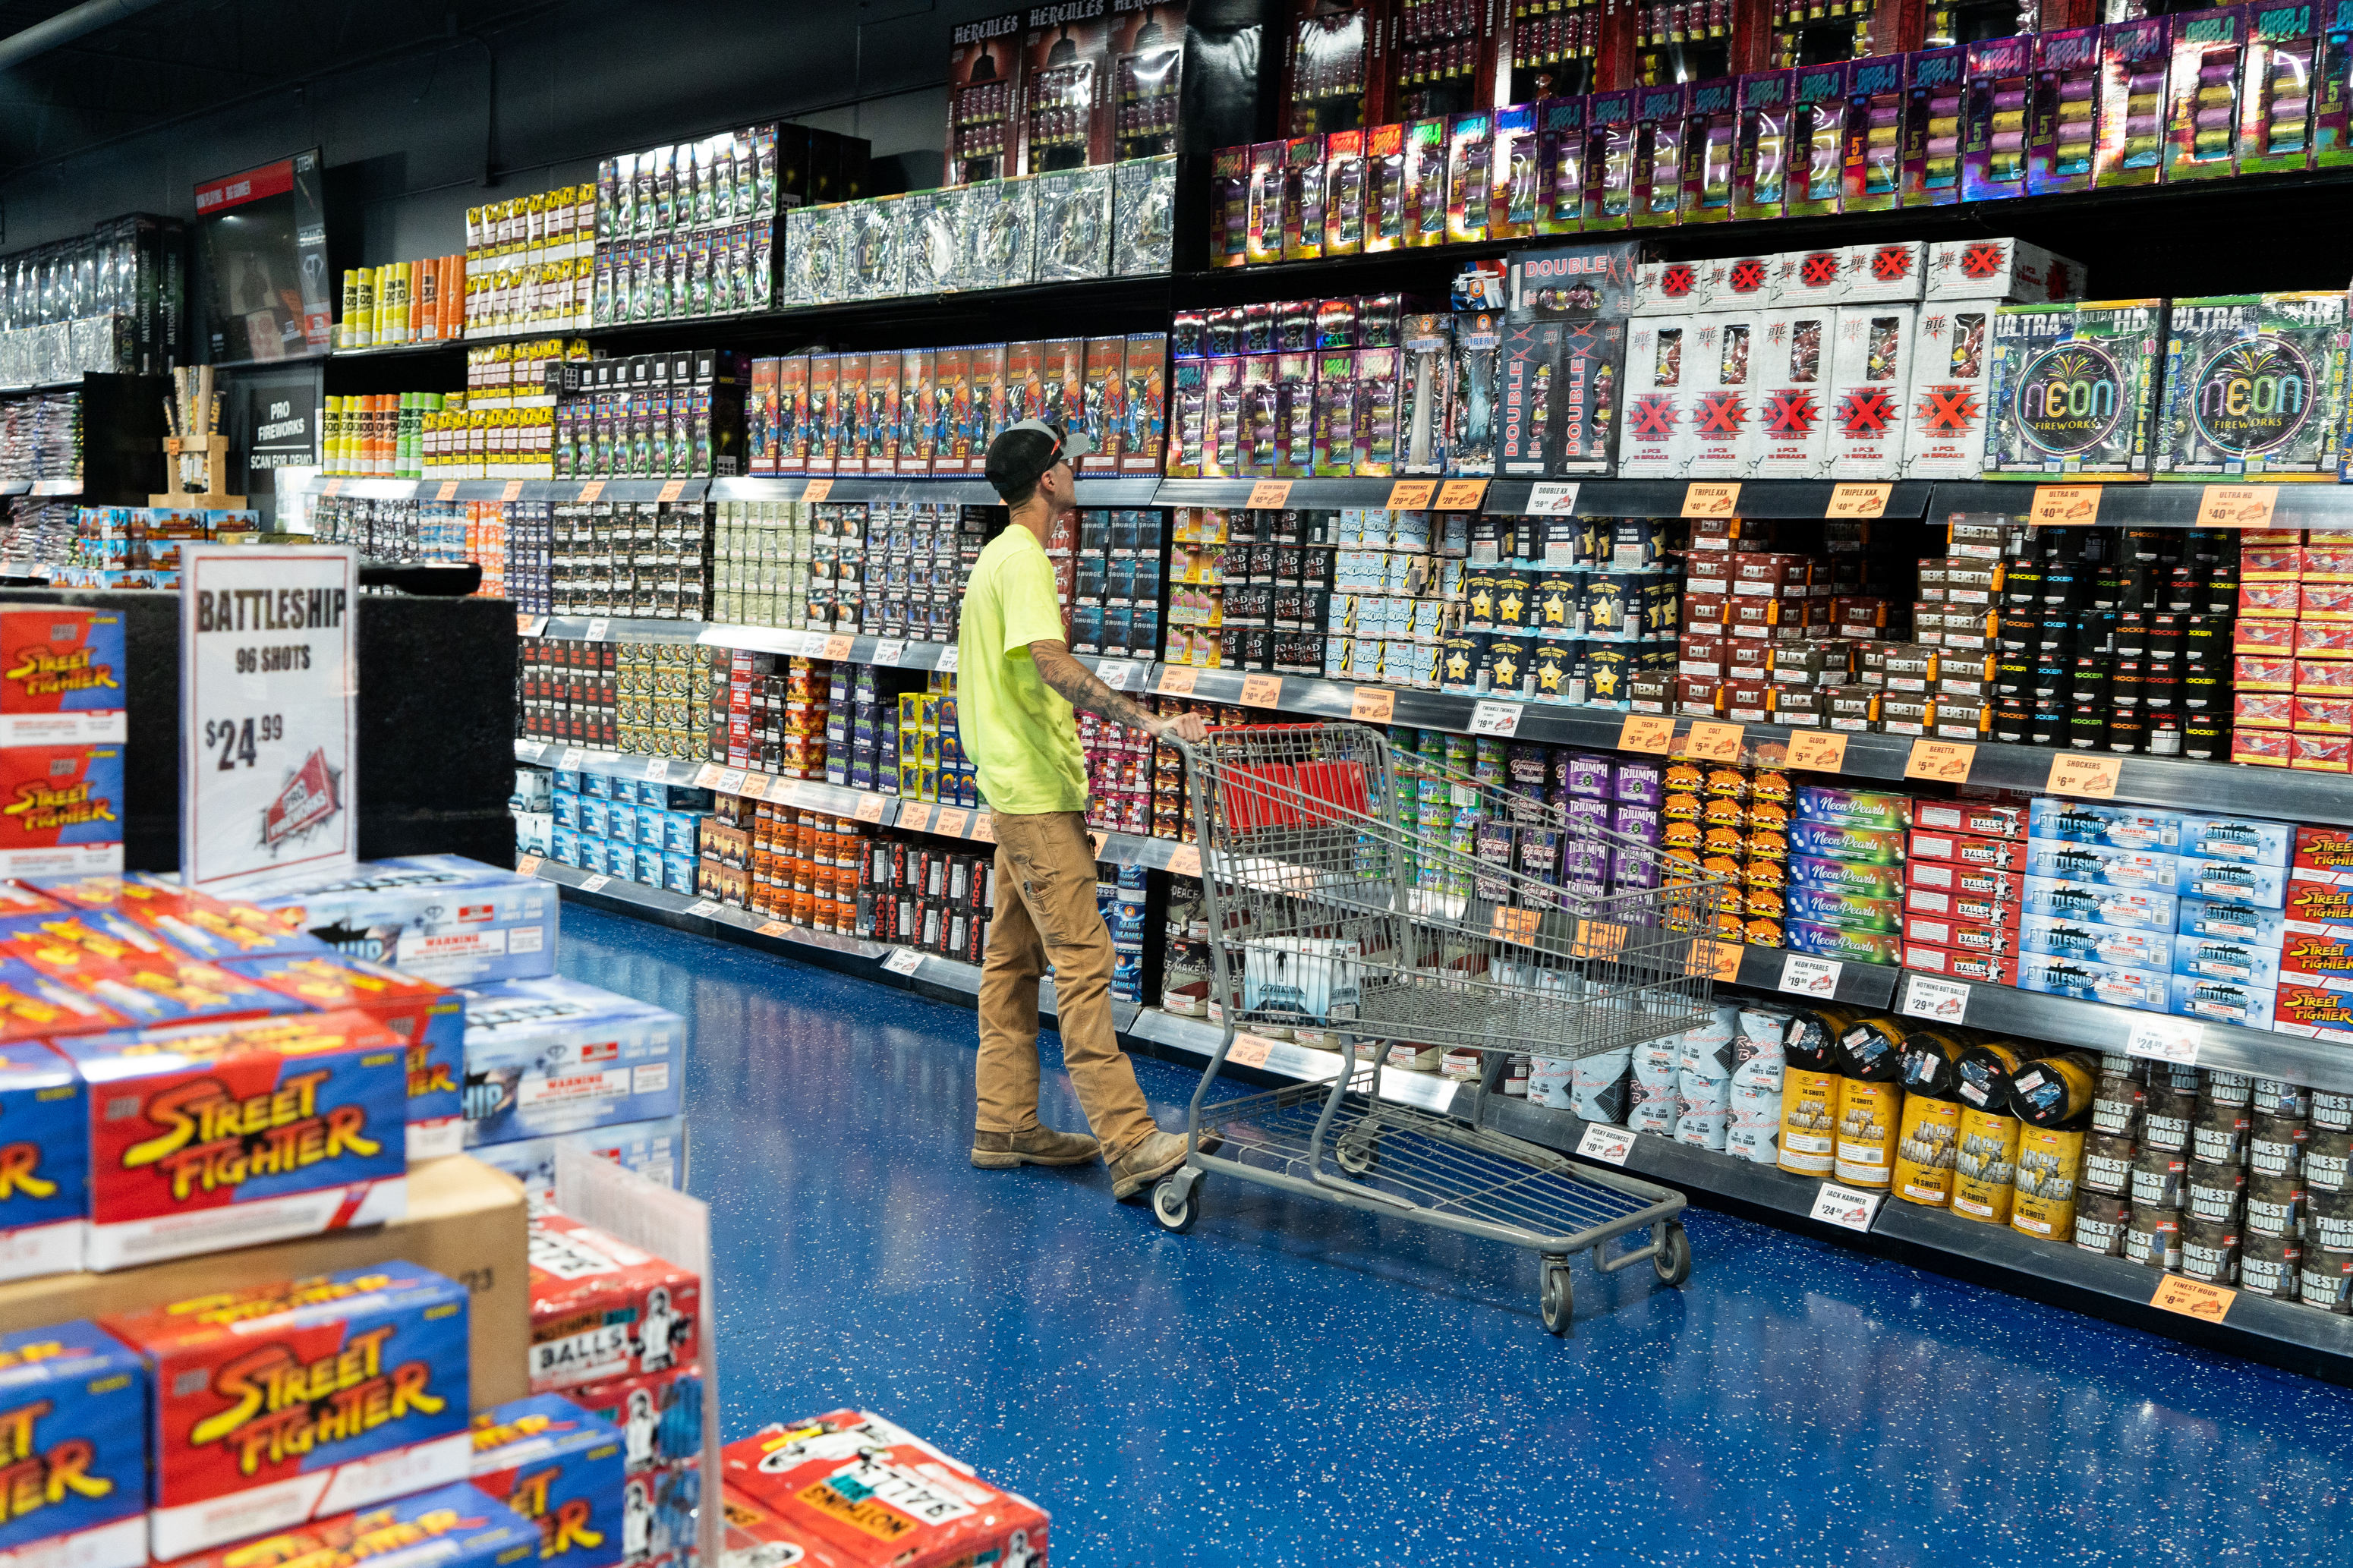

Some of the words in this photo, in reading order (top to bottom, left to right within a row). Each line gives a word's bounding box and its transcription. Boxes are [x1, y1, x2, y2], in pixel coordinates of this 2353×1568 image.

[1029, 0, 1104, 27] HERCULES
[954, 15, 1018, 44] HERCULES
[2328, 80, 2343, 102] 5
[1526, 255, 1608, 278] DOUBLE
[1939, 254, 1955, 263] BIG
[142, 250, 150, 292] DEFENSE
[142, 298, 150, 343] NATIONAL
[2112, 308, 2149, 332] HD
[2172, 307, 2243, 331] ULTRA
[2303, 301, 2342, 325] HD
[1926, 320, 1945, 329] BIG
[1996, 313, 2061, 337] ULTRA
[1464, 336, 1501, 346] LIBERTY
[2142, 339, 2155, 355] 10
[2336, 334, 2349, 348] 10
[270, 401, 290, 420] PRO
[1504, 361, 1523, 456] DOUBLE
[1566, 358, 1586, 456] DOUBLE
[2134, 358, 2151, 454] SHELLS
[258, 417, 304, 442] FIREWORKS
[2036, 420, 2096, 430] FIREWORKS
[2215, 418, 2282, 429] FIREWORKS
[250, 455, 272, 470] SCAN
[272, 454, 287, 468] FOR
[290, 454, 313, 464] DEMO
[1695, 488, 1715, 496] TRIPLE
[1954, 524, 1998, 539] BERETTA
[1743, 565, 1766, 578] COLT
[197, 588, 346, 632] BATTLESHIP
[7, 643, 96, 679] STREET
[236, 647, 257, 673] 96
[261, 645, 310, 672] SHOTS
[1776, 651, 1807, 665] GLOCK
[1633, 683, 1663, 696] TECH-9
[1689, 685, 1710, 697] COLT
[1781, 694, 1813, 707] GLOCK
[1082, 716, 1092, 725] Tik
[1938, 706, 1980, 720] BERETTA
[206, 714, 282, 771] $24.99
[1809, 736, 1827, 745] GLOCK
[1795, 751, 1811, 761] $5.00
[1929, 746, 1955, 754] BERETTA
[1570, 760, 1608, 779] TRIUMPH
[1917, 760, 1935, 771] $5.00
[2067, 760, 2100, 770] SHOCKERS
[1620, 767, 1658, 785] TRIUMPH
[2057, 776, 2076, 787] $6.00
[4, 777, 95, 814] STREET
[1820, 796, 1848, 814] Neon
[1849, 799, 1885, 817] Pearls
[2040, 814, 2106, 835] BATTLESHIP
[2207, 827, 2260, 844] BATTLESHIP
[1964, 849, 1992, 859] BALLS
[894, 843, 903, 888] HAVOC
[972, 862, 983, 908] HAVOC
[425, 933, 480, 946] WARNING
[1810, 929, 1838, 947] Neon
[1838, 934, 1875, 953] Pearls
[1794, 960, 1808, 968] NEON
[1809, 962, 1829, 972] PEARLS
[1788, 975, 1807, 986] $19.99
[2027, 967, 2093, 989] BATTLESHIP
[1917, 981, 1938, 991] NOTHING
[1950, 987, 1966, 996] BALLS
[1913, 999, 1934, 1010] $29.99
[2284, 988, 2339, 1007] STREET
[2295, 1006, 2353, 1022] FIGHTER
[2137, 1037, 2162, 1050] $24.99
[548, 1073, 603, 1089] WARNING
[1630, 1080, 1667, 1096] Risky
[124, 1069, 332, 1168] STREET
[2146, 1113, 2191, 1132] FINEST
[1592, 1128, 1605, 1137] RISKY
[1606, 1130, 1630, 1143] BUSINESS
[2147, 1127, 2185, 1145] HOUR
[159, 1105, 381, 1201] FIGHTER
[1586, 1141, 1603, 1151] $19.99
[2087, 1154, 2129, 1173] FINEST
[2087, 1168, 2124, 1186] HOUR
[1826, 1189, 1841, 1199] JACK
[1841, 1194, 1866, 1205] HAMMER
[2191, 1183, 2235, 1203] FINEST
[1822, 1204, 1843, 1216] $24.99
[2192, 1198, 2230, 1217] HOUR
[2174, 1281, 2197, 1292] FINEST
[2198, 1287, 2218, 1298] HOUR
[2164, 1294, 2185, 1305] $8.00
[540, 1331, 622, 1368] BALLS
[191, 1324, 398, 1445] STREET
[230, 1361, 446, 1476] FIGHTER
